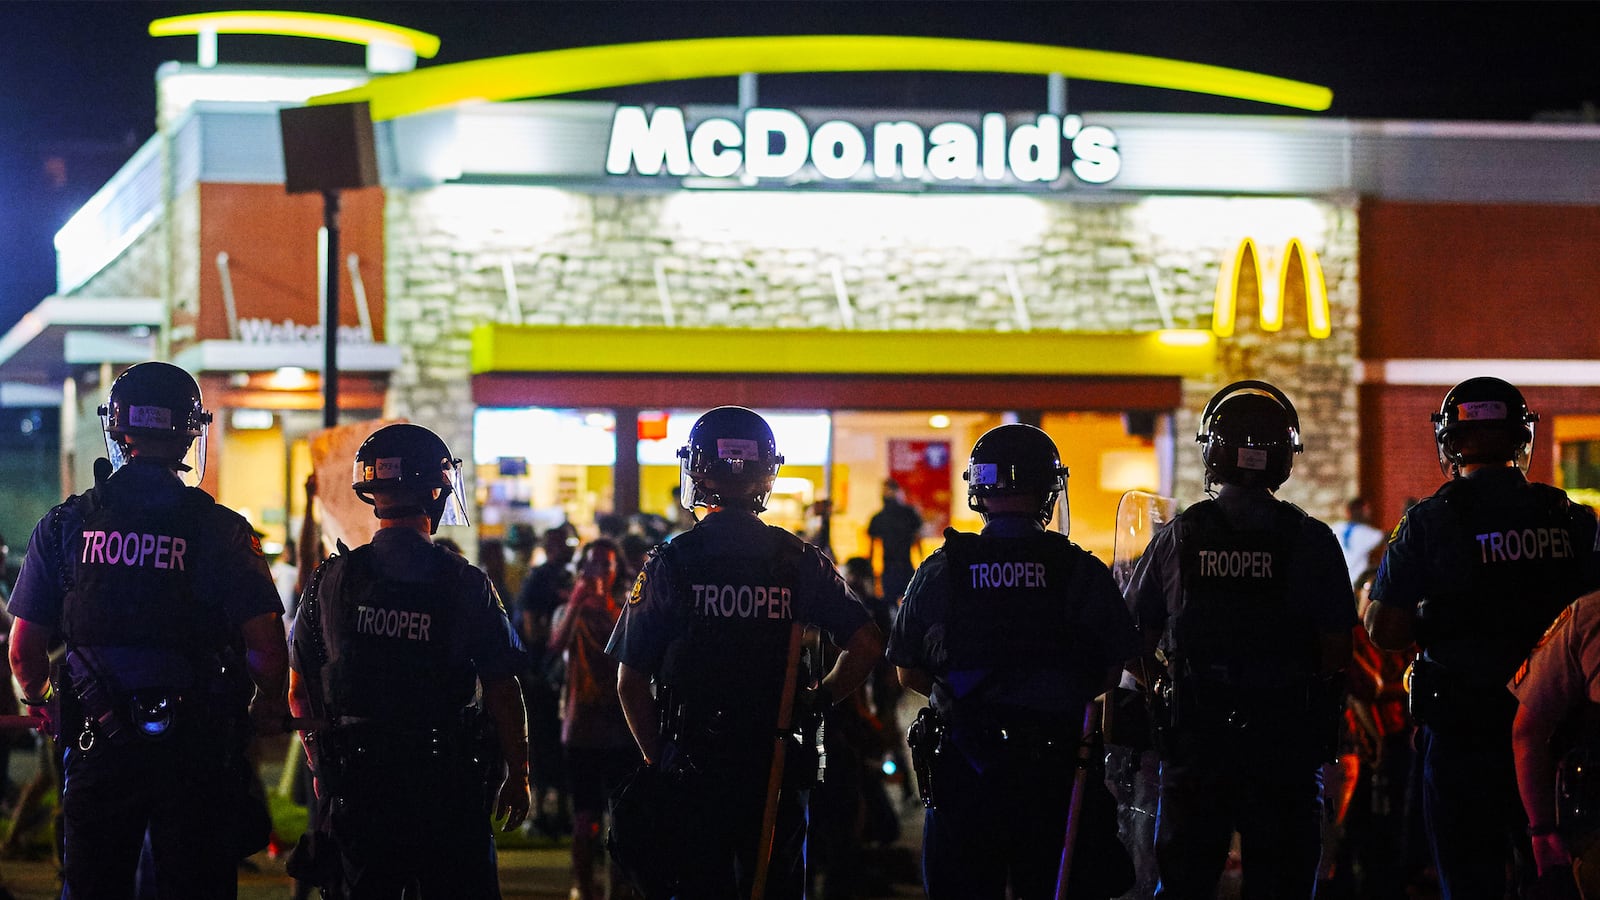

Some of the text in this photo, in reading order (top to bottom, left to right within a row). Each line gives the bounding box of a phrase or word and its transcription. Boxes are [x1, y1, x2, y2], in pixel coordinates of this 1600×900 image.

[605, 105, 1121, 183] McDonald's
[82, 530, 187, 572] TROOPER
[1198, 550, 1273, 578] TROOPER
[1476, 528, 1575, 564] TROOPER
[969, 561, 1047, 590] TROOPER
[691, 584, 793, 620] TROOPER
[356, 605, 432, 642] TROOPER
